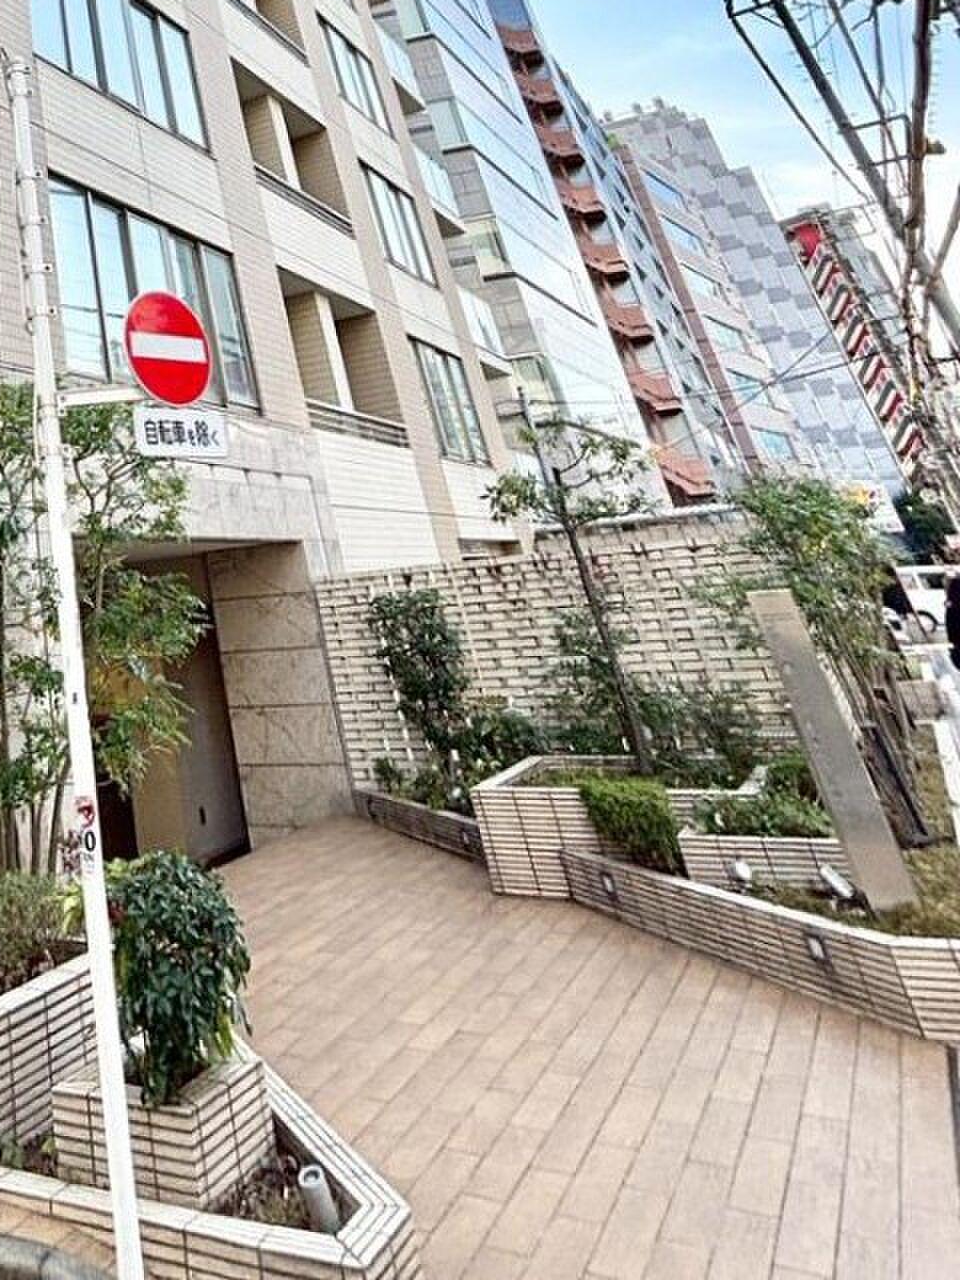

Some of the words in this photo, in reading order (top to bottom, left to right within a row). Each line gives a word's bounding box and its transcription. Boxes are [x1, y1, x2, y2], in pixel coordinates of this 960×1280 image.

[144, 419, 220, 448] 自転車を除く
